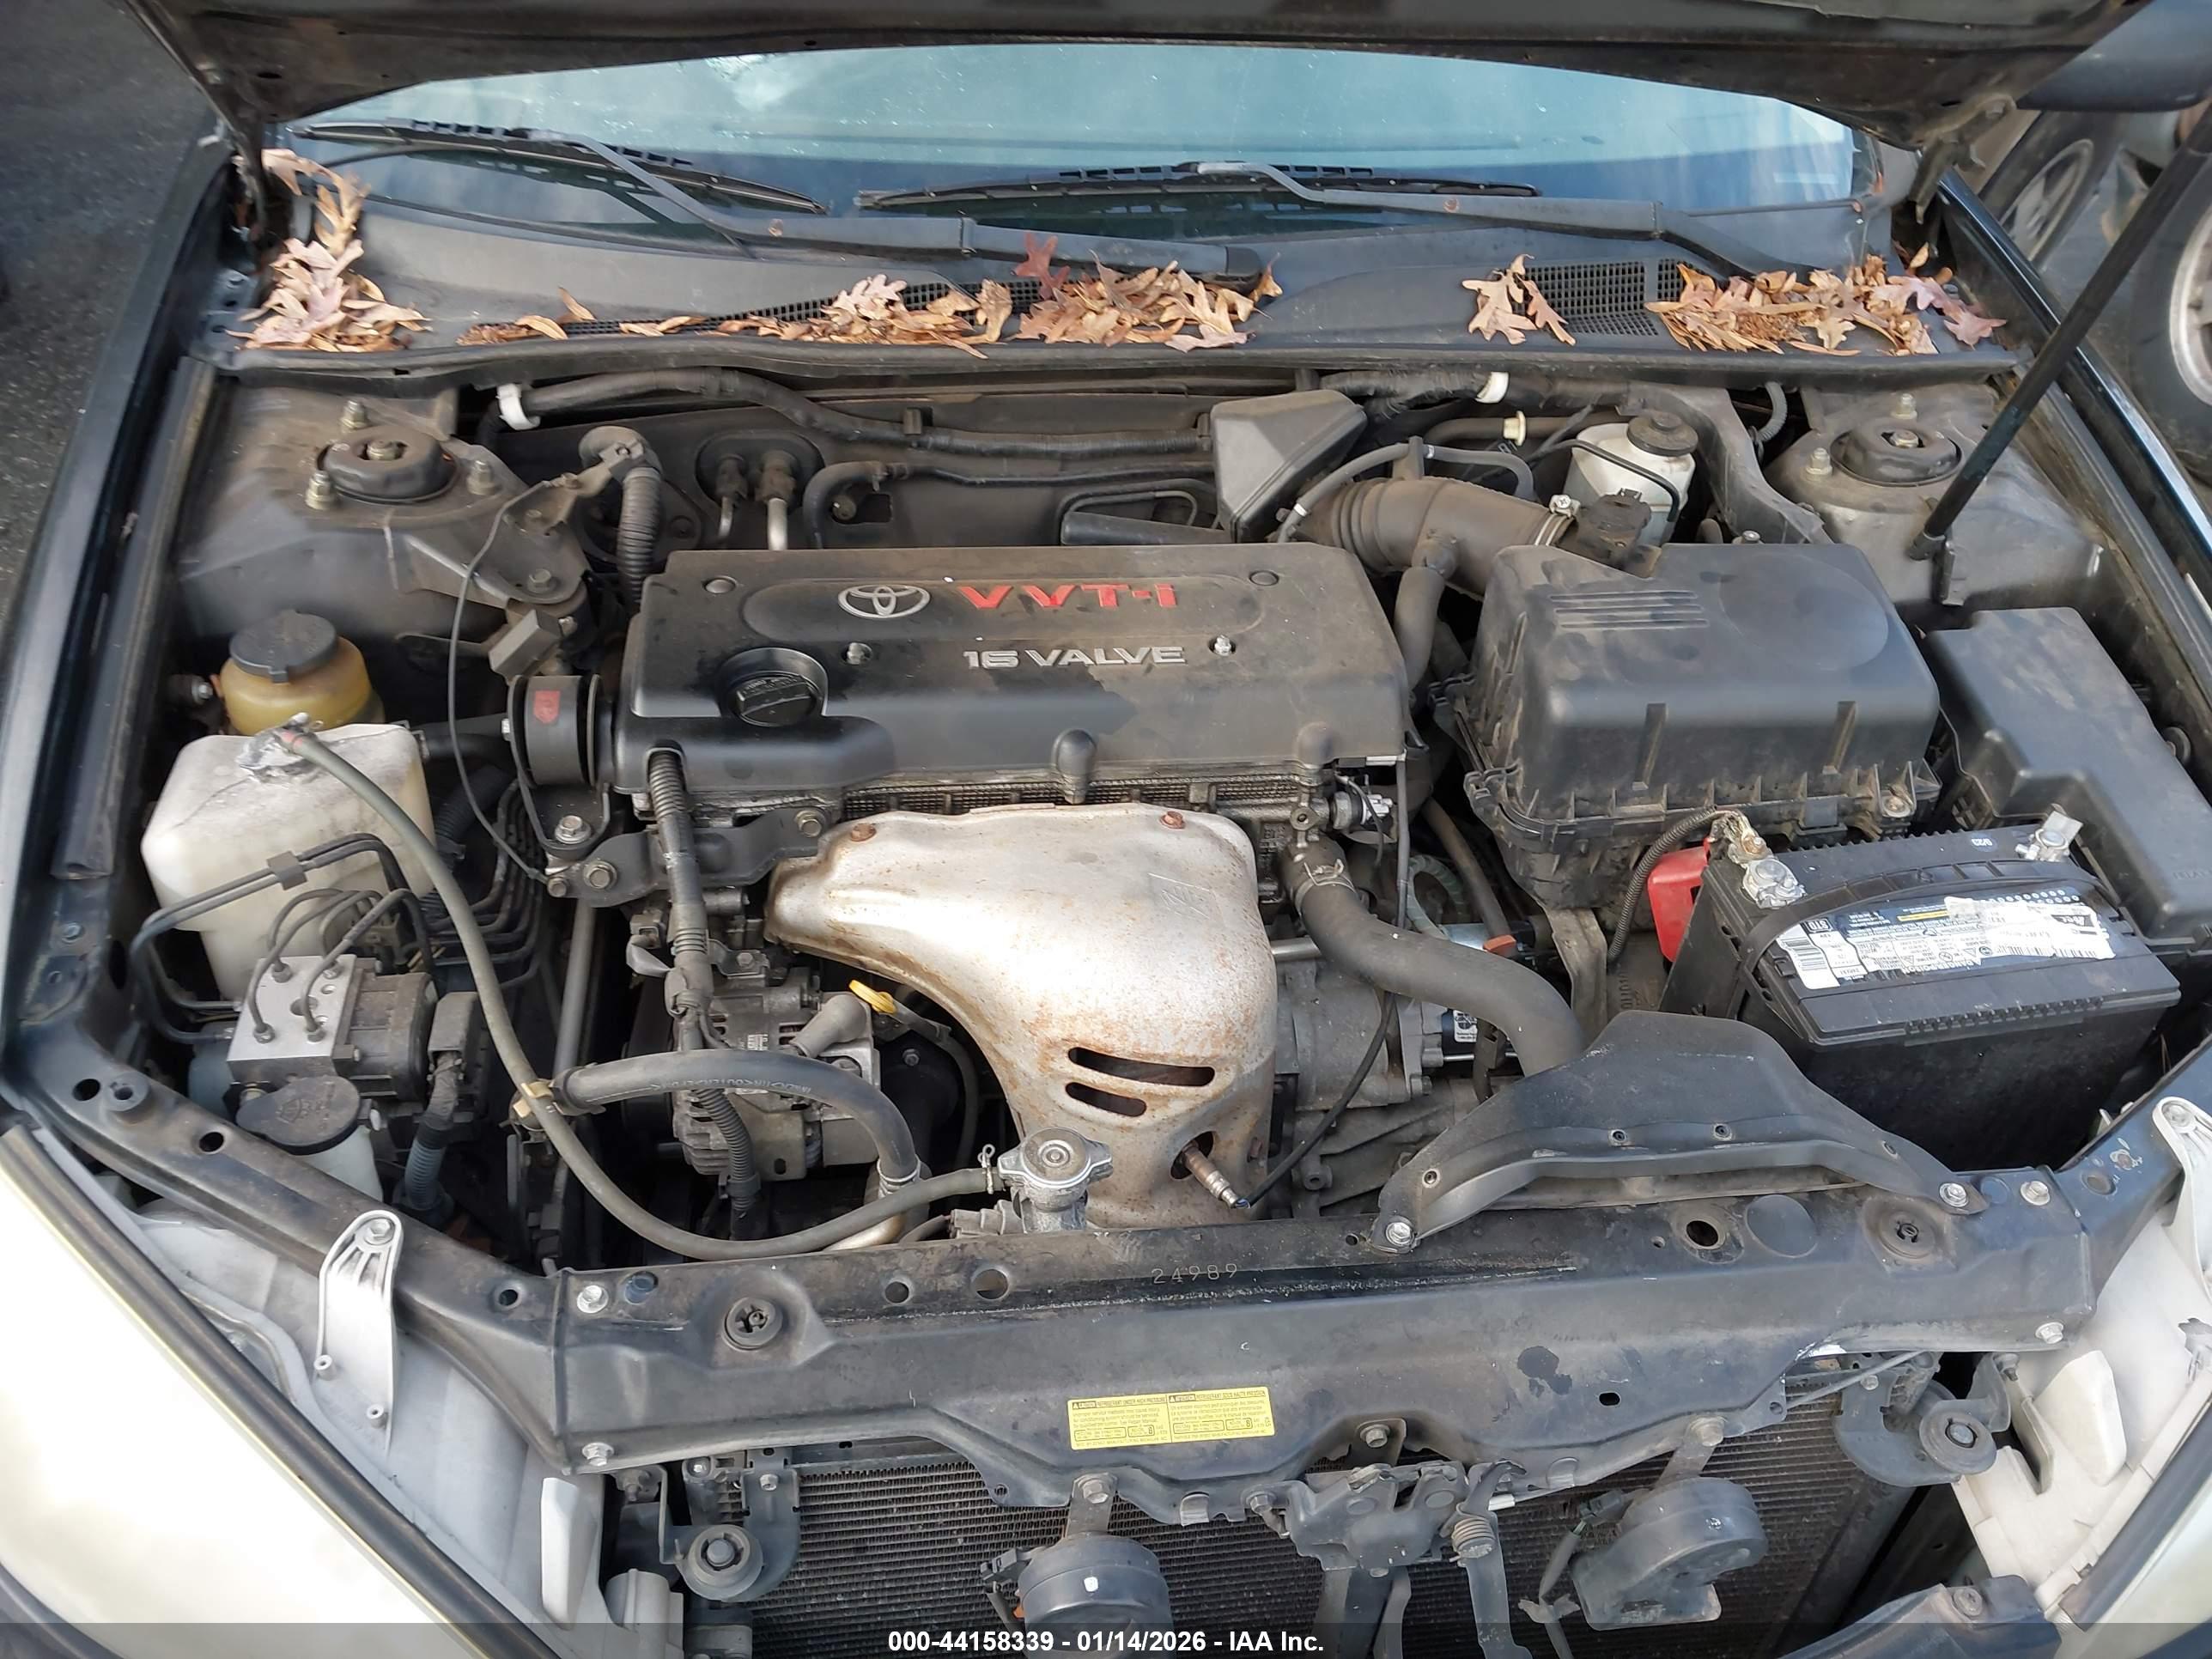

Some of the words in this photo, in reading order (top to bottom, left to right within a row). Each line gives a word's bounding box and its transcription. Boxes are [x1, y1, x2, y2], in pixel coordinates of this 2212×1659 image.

[963, 650, 1019, 669] 16
[1024, 646, 1188, 667] VALVE
[1152, 1263, 1237, 1284] 24989
